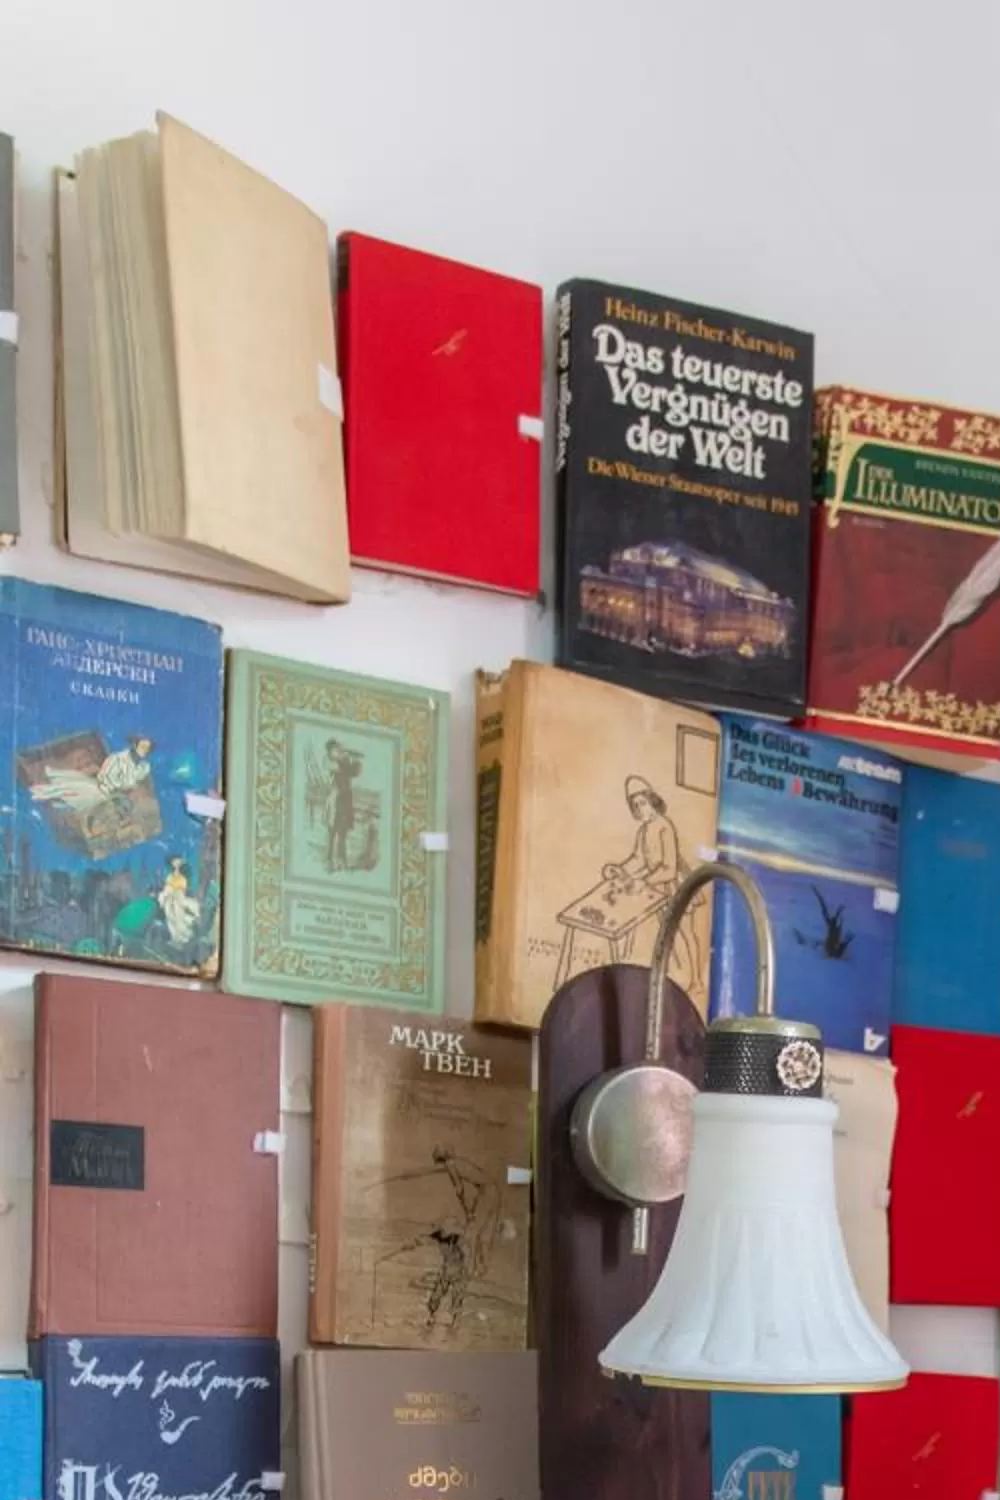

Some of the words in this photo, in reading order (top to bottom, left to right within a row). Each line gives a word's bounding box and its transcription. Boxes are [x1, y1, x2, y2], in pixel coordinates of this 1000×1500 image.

[604, 297, 659, 328] Heinz
[663, 310, 797, 361] Fischer-Karwin
[592, 324, 664, 376] Das
[671, 344, 803, 408] teuerste
[603, 365, 790, 442] Vergnügen
[586, 456, 614, 477] Die
[625, 416, 685, 461] der
[688, 426, 767, 480] Welt
[388, 1024, 465, 1056] МАРК
[418, 1048, 494, 1080] ТВЕН
